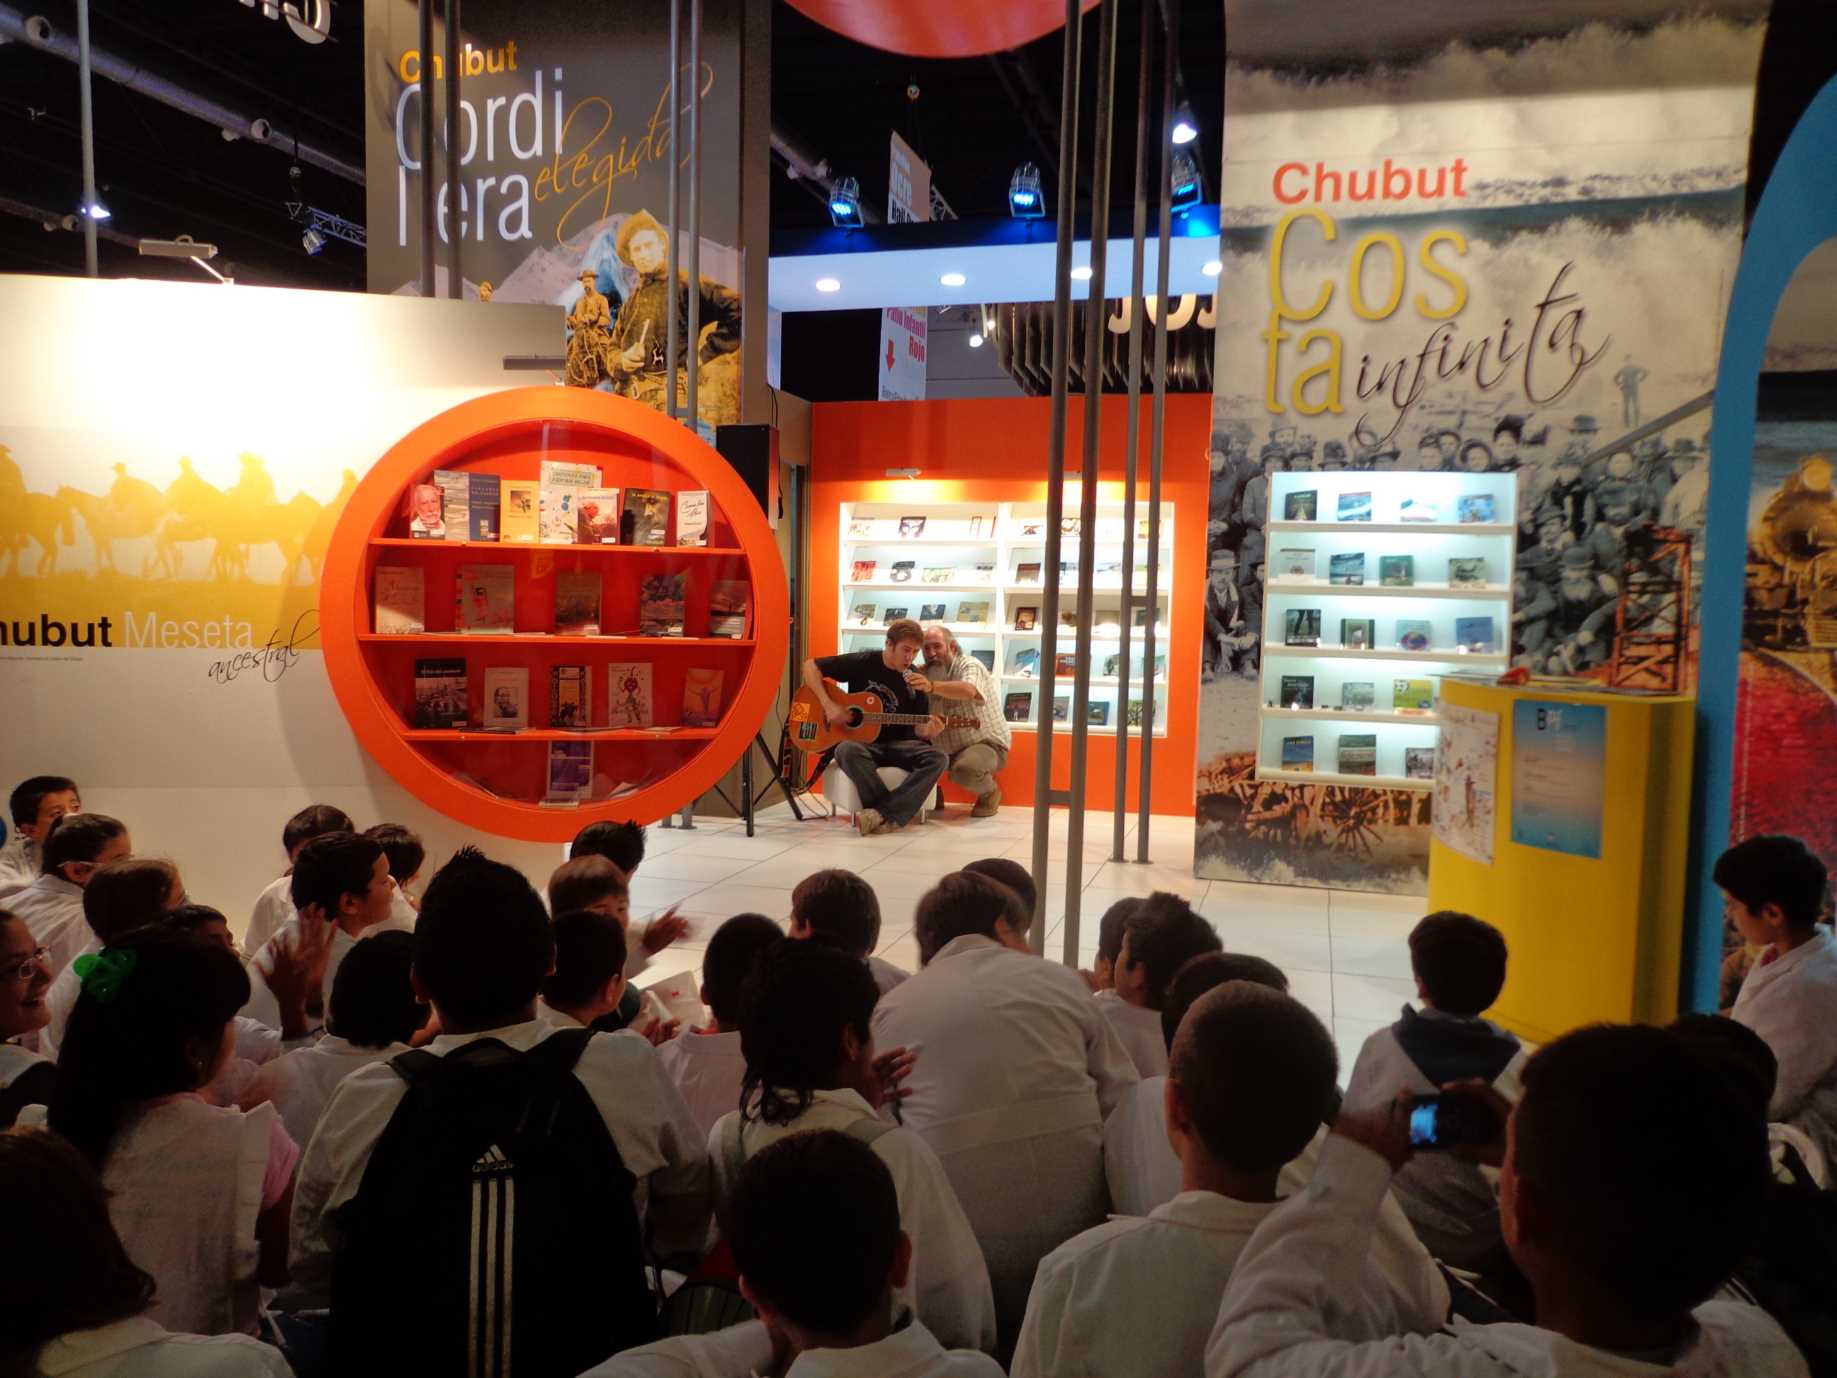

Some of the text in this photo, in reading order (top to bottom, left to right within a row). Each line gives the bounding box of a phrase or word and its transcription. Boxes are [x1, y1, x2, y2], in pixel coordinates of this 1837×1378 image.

[1272, 158, 1468, 205] Chubut
[1268, 207, 1470, 321] Cos
[909, 336, 925, 363] Rojo
[1262, 308, 1346, 416] ta
[1354, 260, 1611, 448] infinita
[123, 611, 254, 650] Meseta
[207, 609, 320, 684] ancestral
